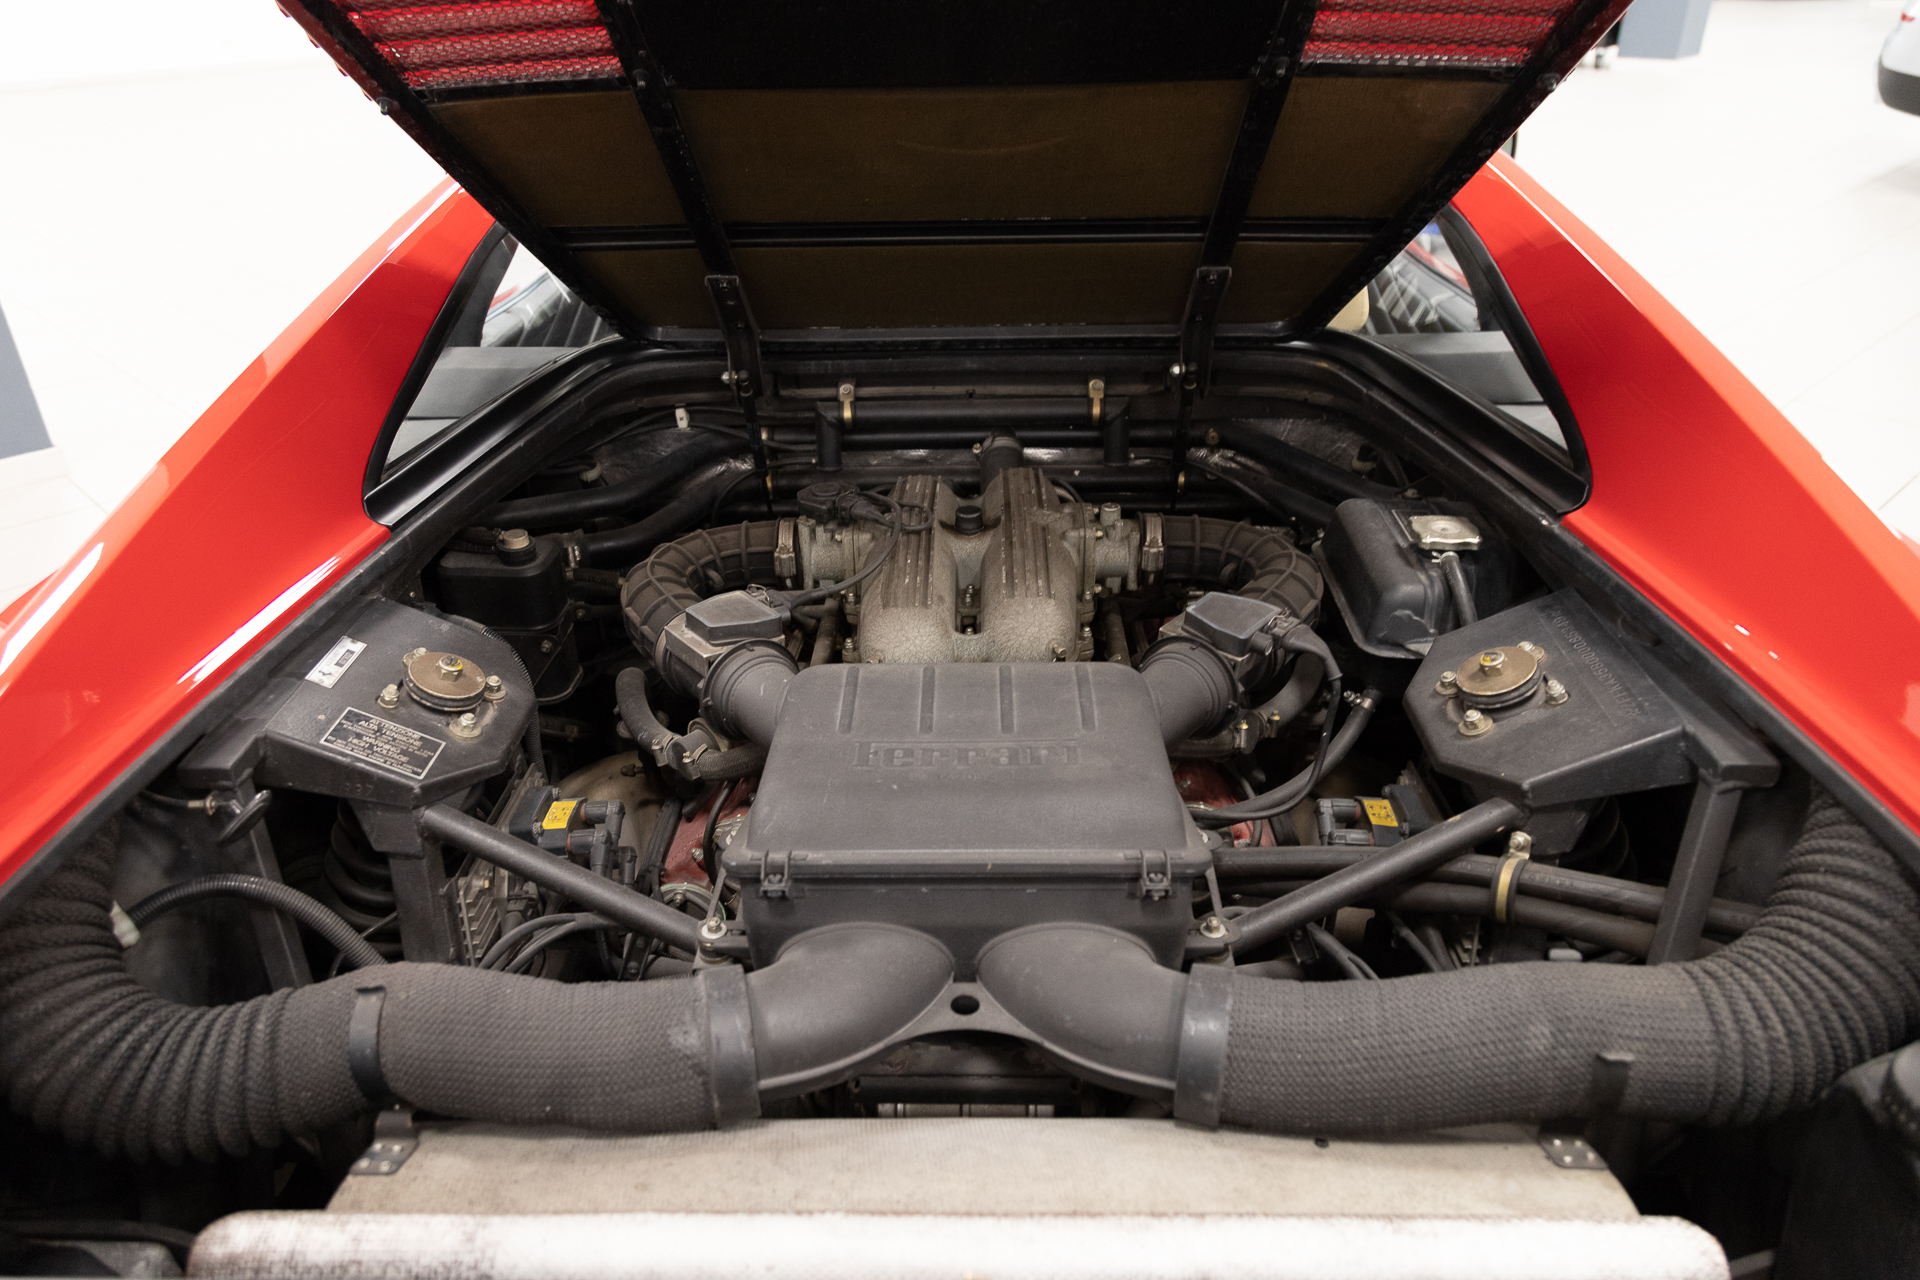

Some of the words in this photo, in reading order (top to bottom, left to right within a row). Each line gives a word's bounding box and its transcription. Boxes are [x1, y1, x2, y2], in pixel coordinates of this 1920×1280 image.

[357, 719, 379, 730] ALTA
[380, 728, 422, 746] TENSIONE
[369, 718, 420, 739] ATTENZIONE
[347, 736, 369, 747] HIGH
[371, 745, 409, 762] VOLTAGE
[361, 735, 401, 753] WARNING
[852, 740, 1081, 768] Ferrari
